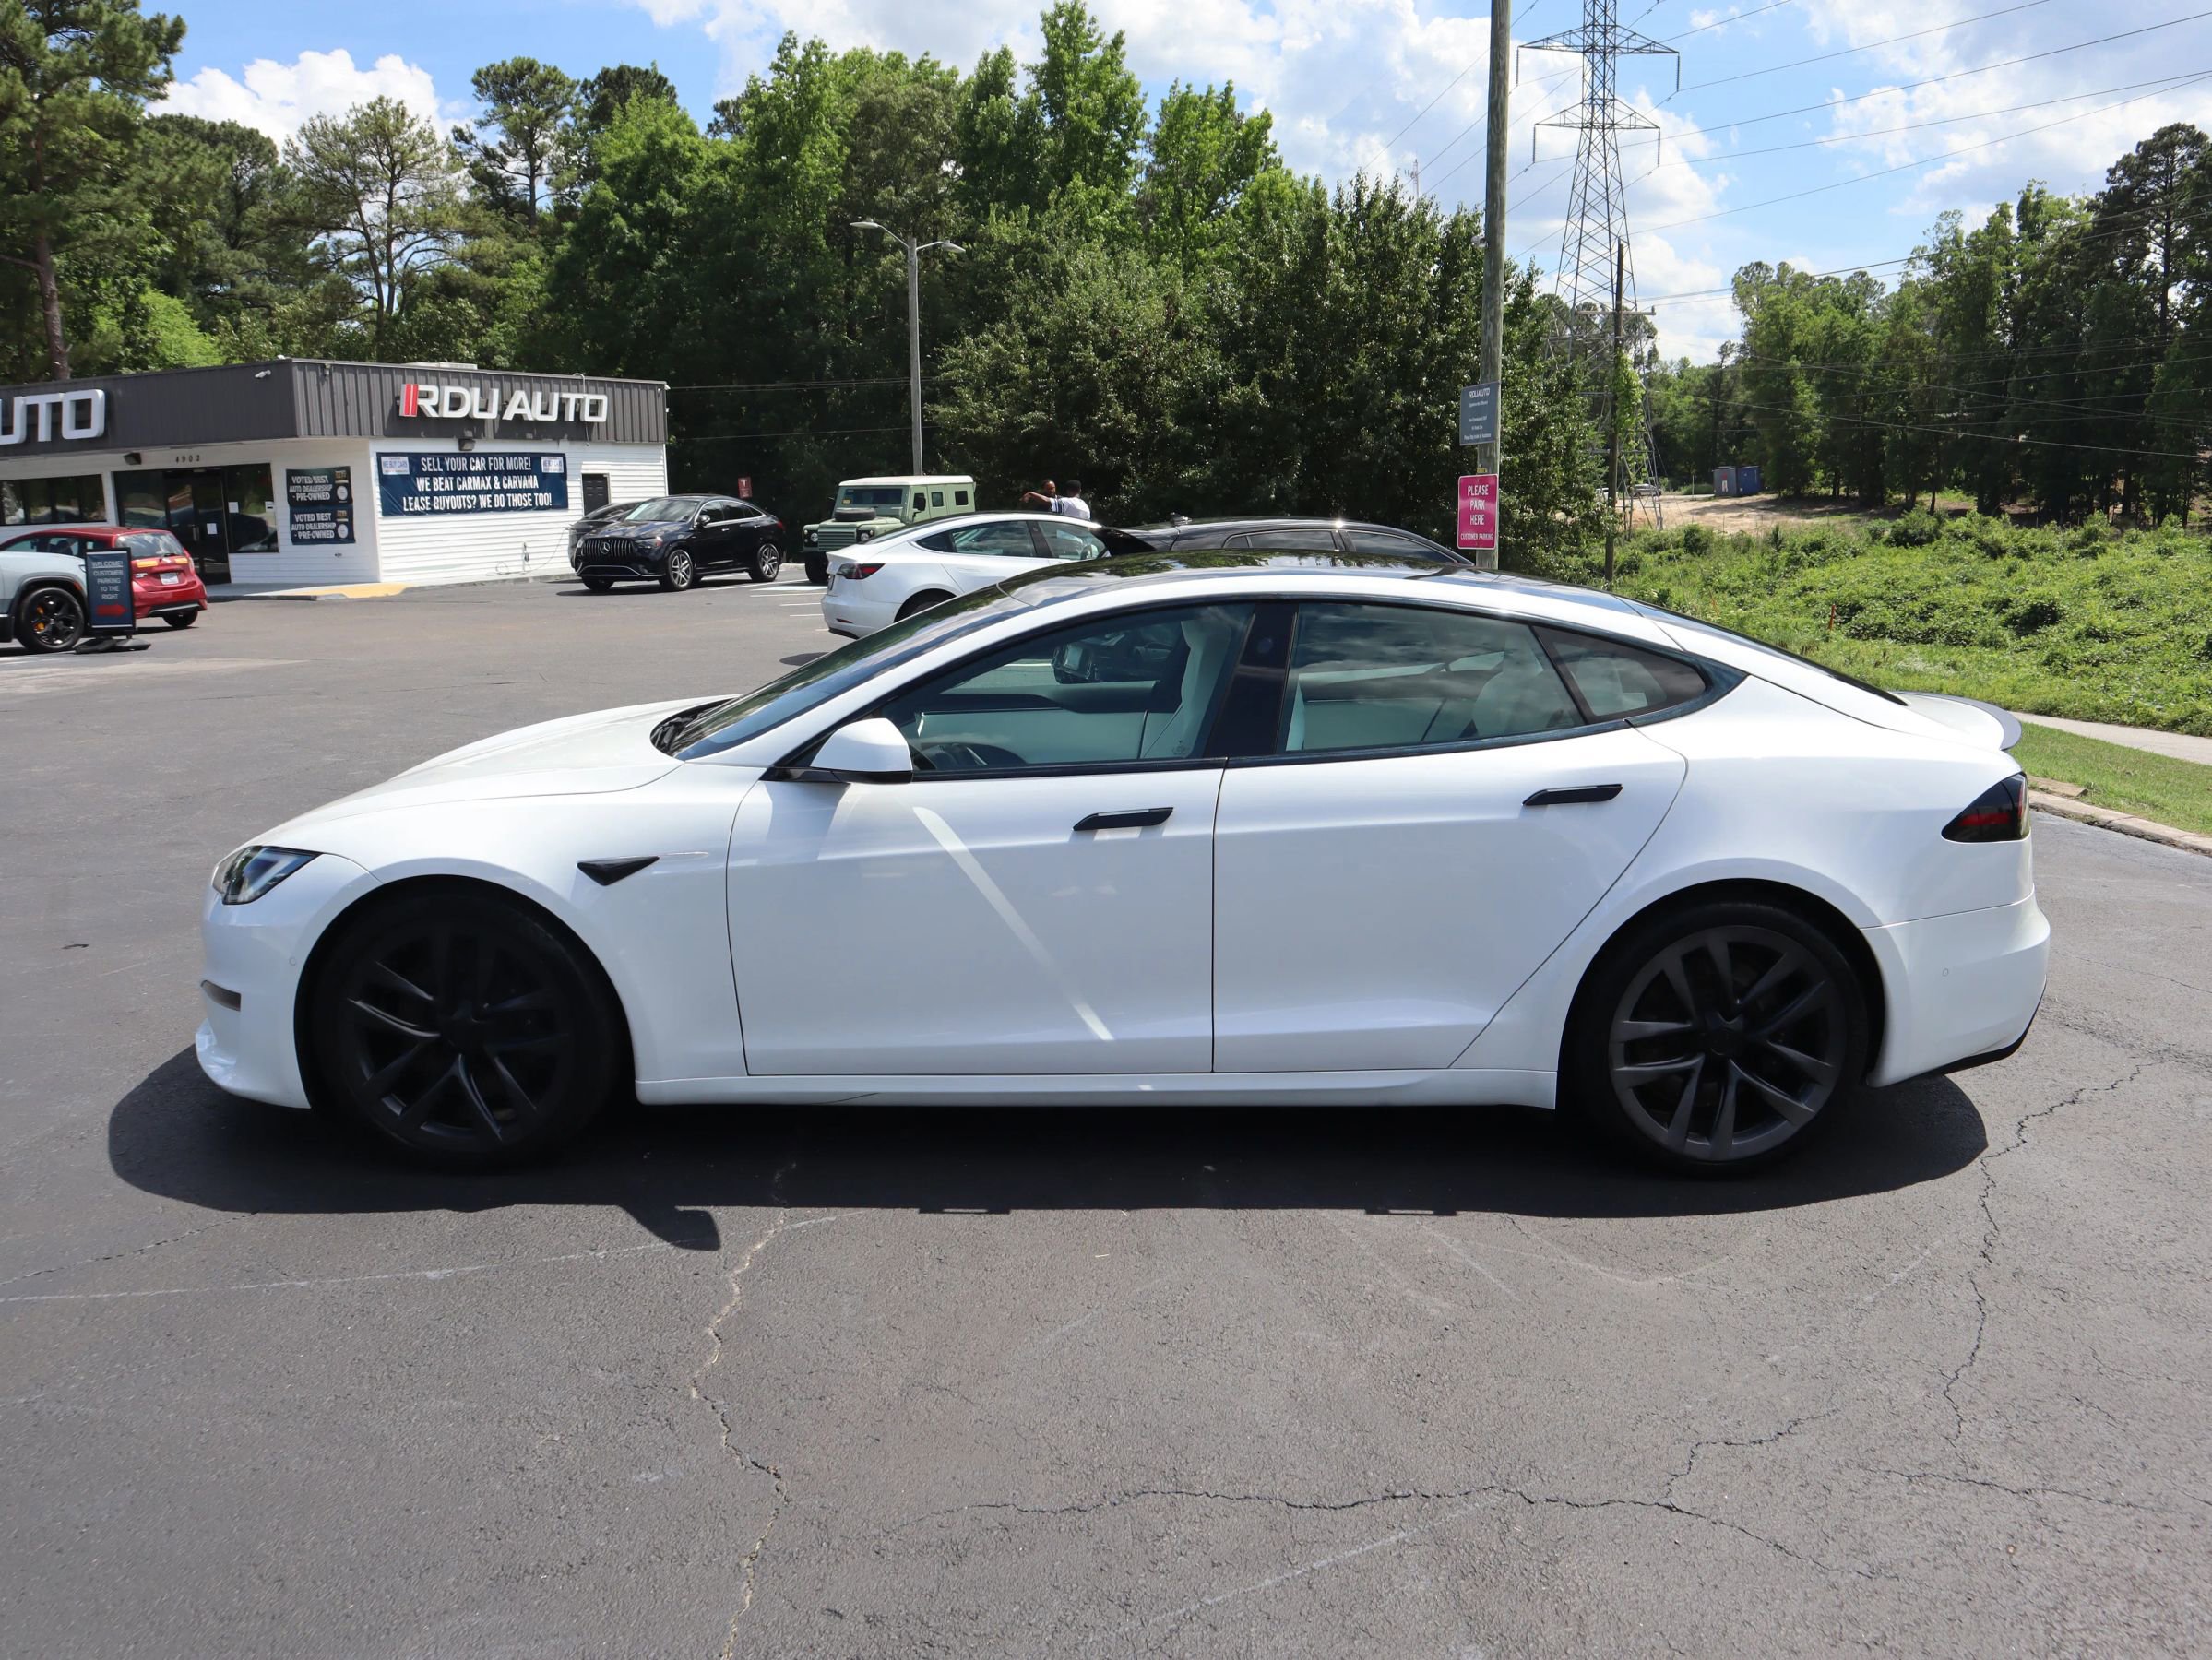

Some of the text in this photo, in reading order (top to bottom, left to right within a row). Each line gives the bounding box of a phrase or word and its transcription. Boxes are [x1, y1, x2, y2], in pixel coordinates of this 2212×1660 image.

[399, 383, 608, 422] RDU AUTO
[175, 454, 200, 464] 4902
[421, 456, 443, 472] SELL
[445, 456, 468, 471] YOUR
[470, 456, 487, 471] CAR
[488, 456, 505, 471] FOR
[505, 456, 532, 471] MORE!
[291, 475, 329, 484] VOTED BEST
[416, 474, 539, 492] WE BEAT CARMAX & CARVANA
[302, 483, 333, 492] DEALERSHIP
[1467, 484, 1489, 497] PLEASE
[295, 492, 331, 502] PRE-OWNED
[403, 492, 553, 512] LEASE BUYOUTS? WE DO THOSE TOO!
[1469, 499, 1485, 511] PARK
[294, 513, 315, 522] VOTED
[315, 512, 332, 521] BEST
[1469, 514, 1485, 526] HERE
[291, 522, 337, 531] AUTO DEALERSHIP
[297, 529, 335, 540] PRE-OWNED
